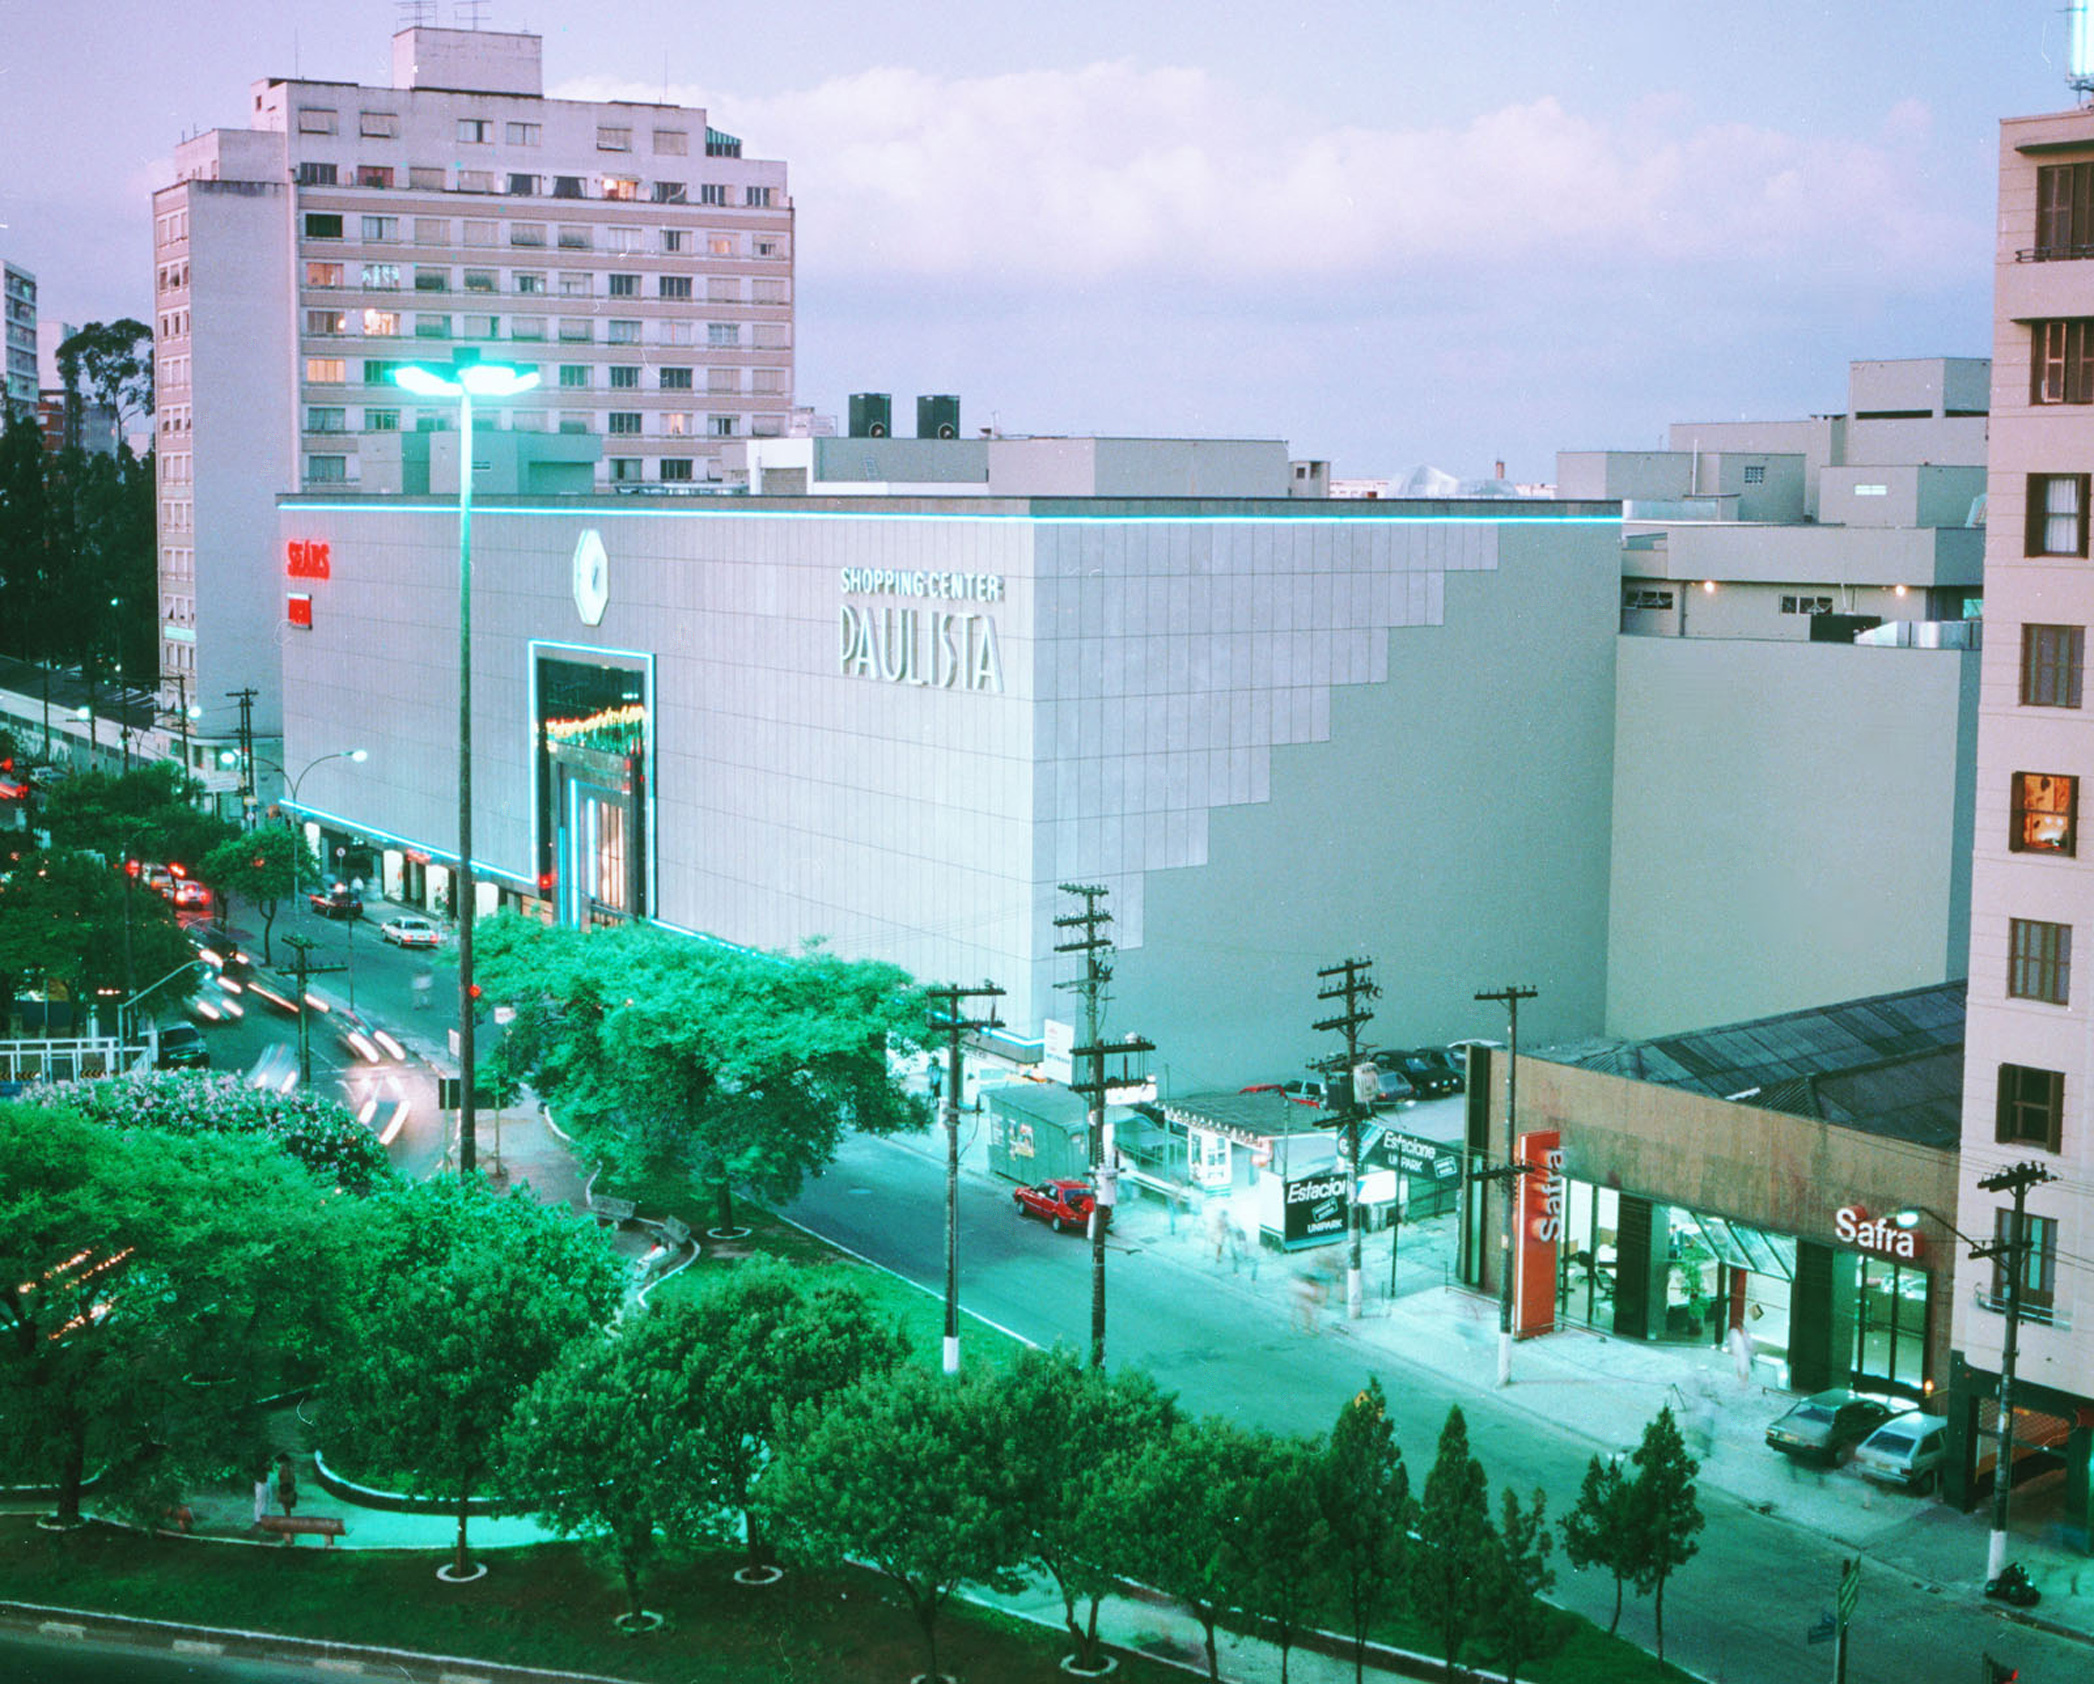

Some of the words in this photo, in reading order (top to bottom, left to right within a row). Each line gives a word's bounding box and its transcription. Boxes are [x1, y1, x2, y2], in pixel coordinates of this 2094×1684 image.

[840, 567, 925, 598] SHOPPING
[927, 571, 1005, 603] CENTER
[839, 603, 1005, 694] PAULISTA
[1383, 1131, 1436, 1160] Estacione
[1539, 1146, 1565, 1243] Safra
[1834, 1207, 1915, 1259] Safra
